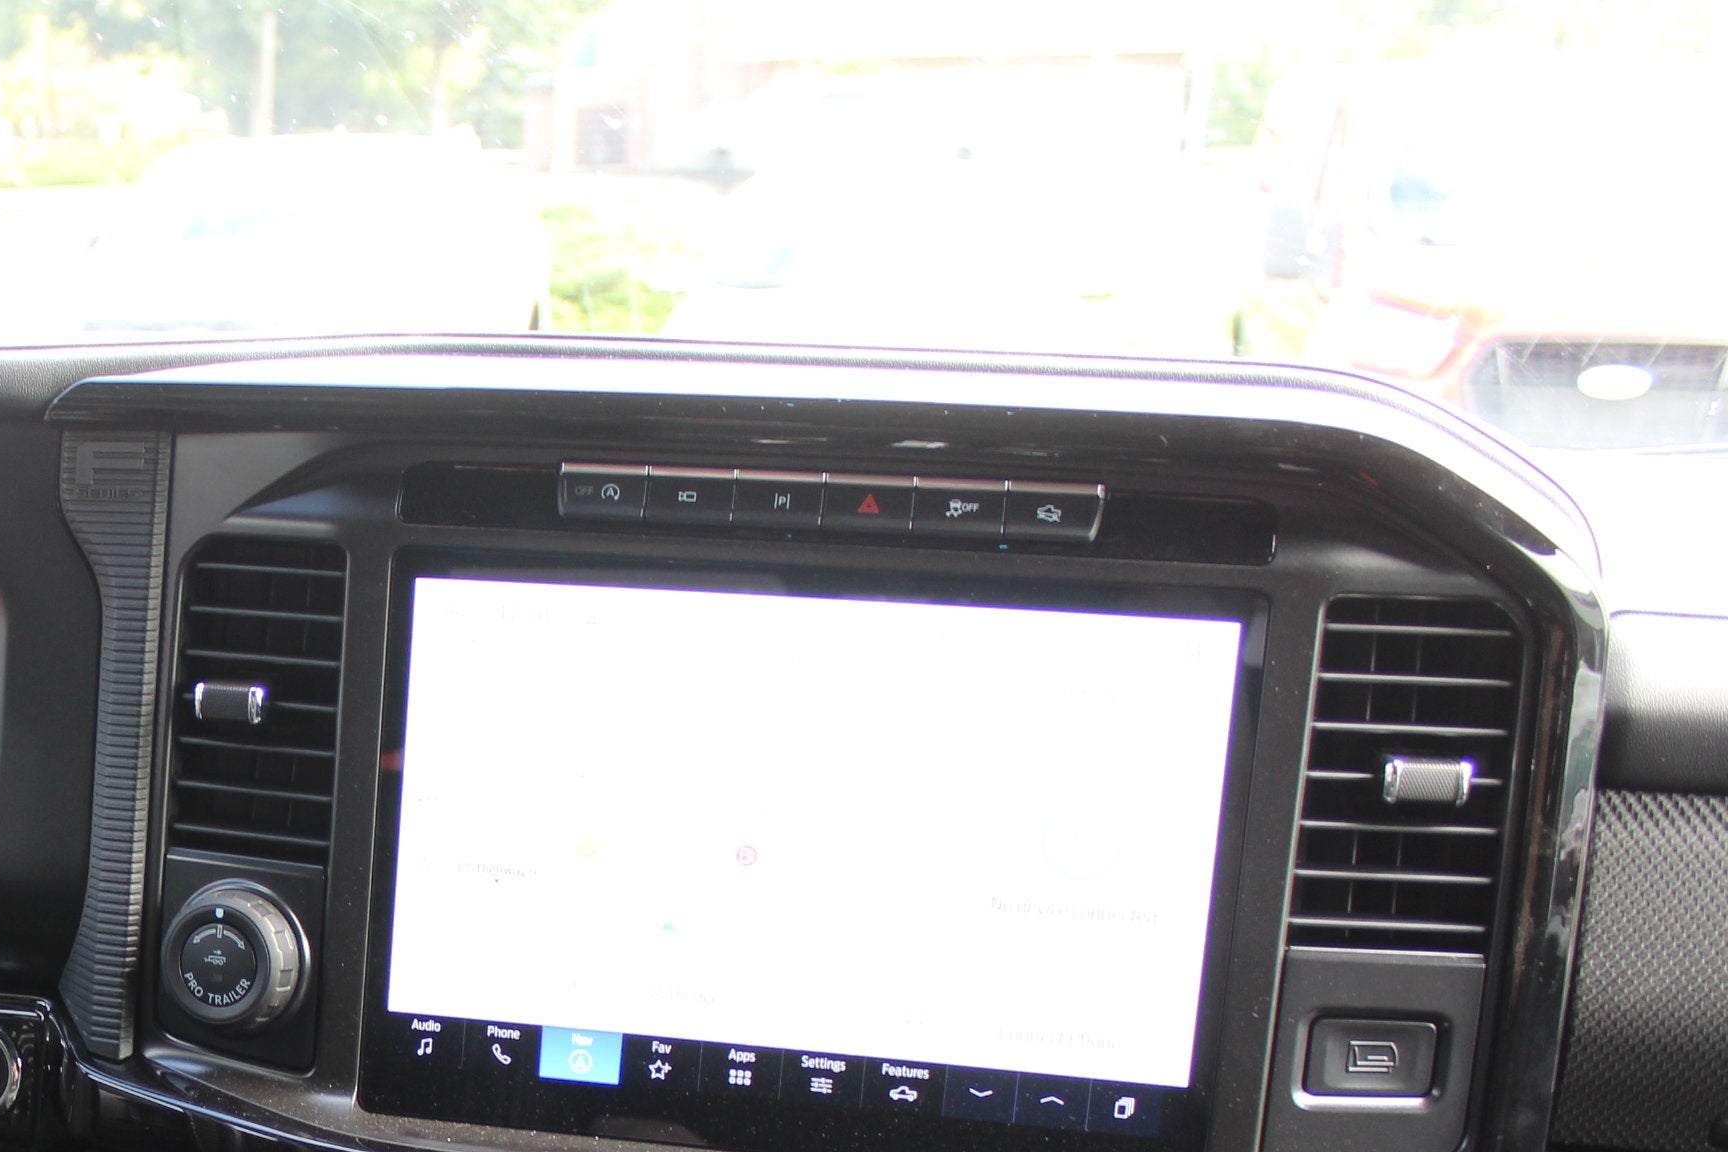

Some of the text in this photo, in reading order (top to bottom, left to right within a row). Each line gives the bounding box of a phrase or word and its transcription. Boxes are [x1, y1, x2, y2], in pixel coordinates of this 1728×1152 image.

[961, 502, 980, 513] OFF
[184, 971, 251, 1006] PRO TRAILER
[411, 1018, 441, 1033] Audio
[487, 1025, 520, 1040] Phone
[571, 1033, 594, 1047] Nav
[652, 1040, 672, 1055] Fav
[728, 1048, 756, 1064] Apps
[801, 1055, 846, 1073] Settings
[881, 1063, 930, 1080] Features
